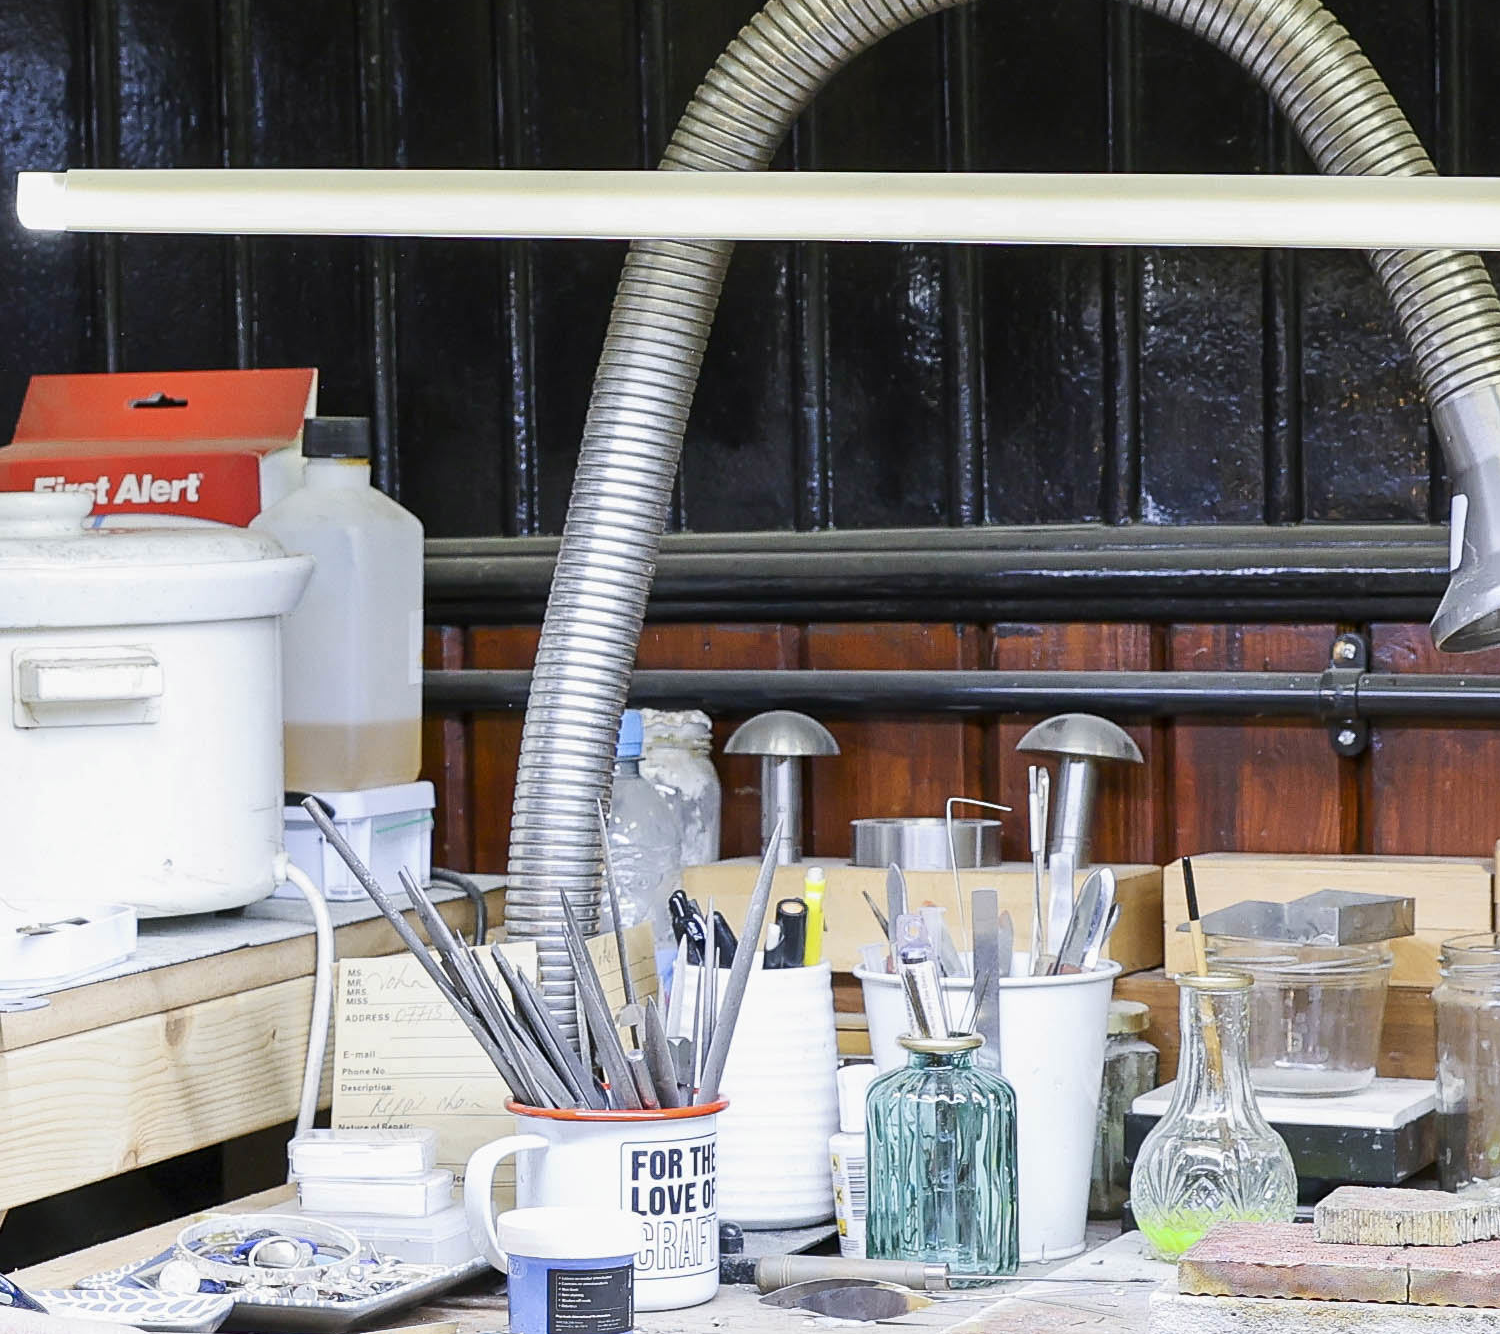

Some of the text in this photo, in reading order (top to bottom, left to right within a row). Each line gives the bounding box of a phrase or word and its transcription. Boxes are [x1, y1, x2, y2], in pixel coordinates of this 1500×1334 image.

[113, 473, 200, 505] Alert
[345, 997, 369, 1005] MISS
[345, 1013, 391, 1023] ADDRESS
[342, 1050, 376, 1059] E-mail
[341, 1068, 371, 1076] Phone
[631, 1141, 716, 1181] FOR THE
[631, 1177, 716, 1217] LOVE OF
